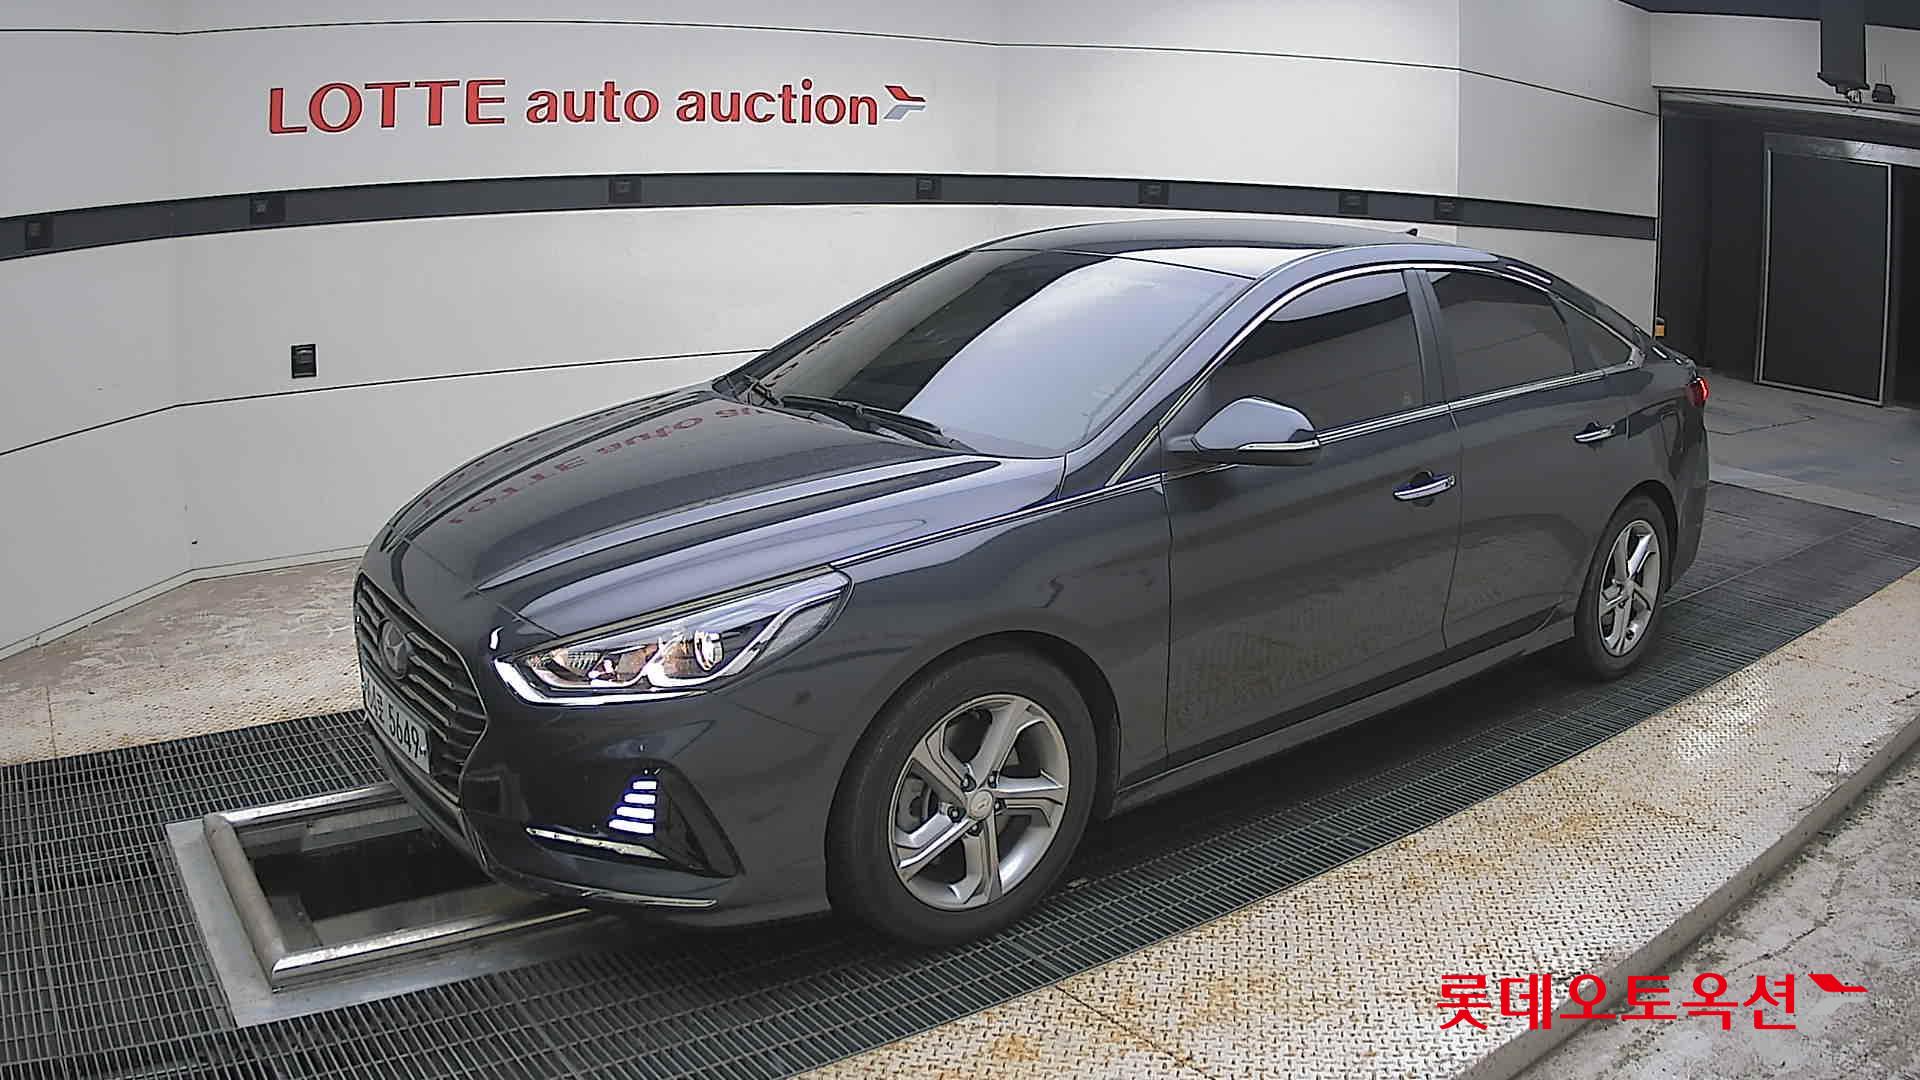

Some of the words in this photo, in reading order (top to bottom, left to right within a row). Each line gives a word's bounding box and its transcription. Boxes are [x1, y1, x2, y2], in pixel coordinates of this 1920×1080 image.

[269, 79, 505, 134] LOTTE
[526, 81, 660, 124] auto
[676, 79, 878, 125] auction
